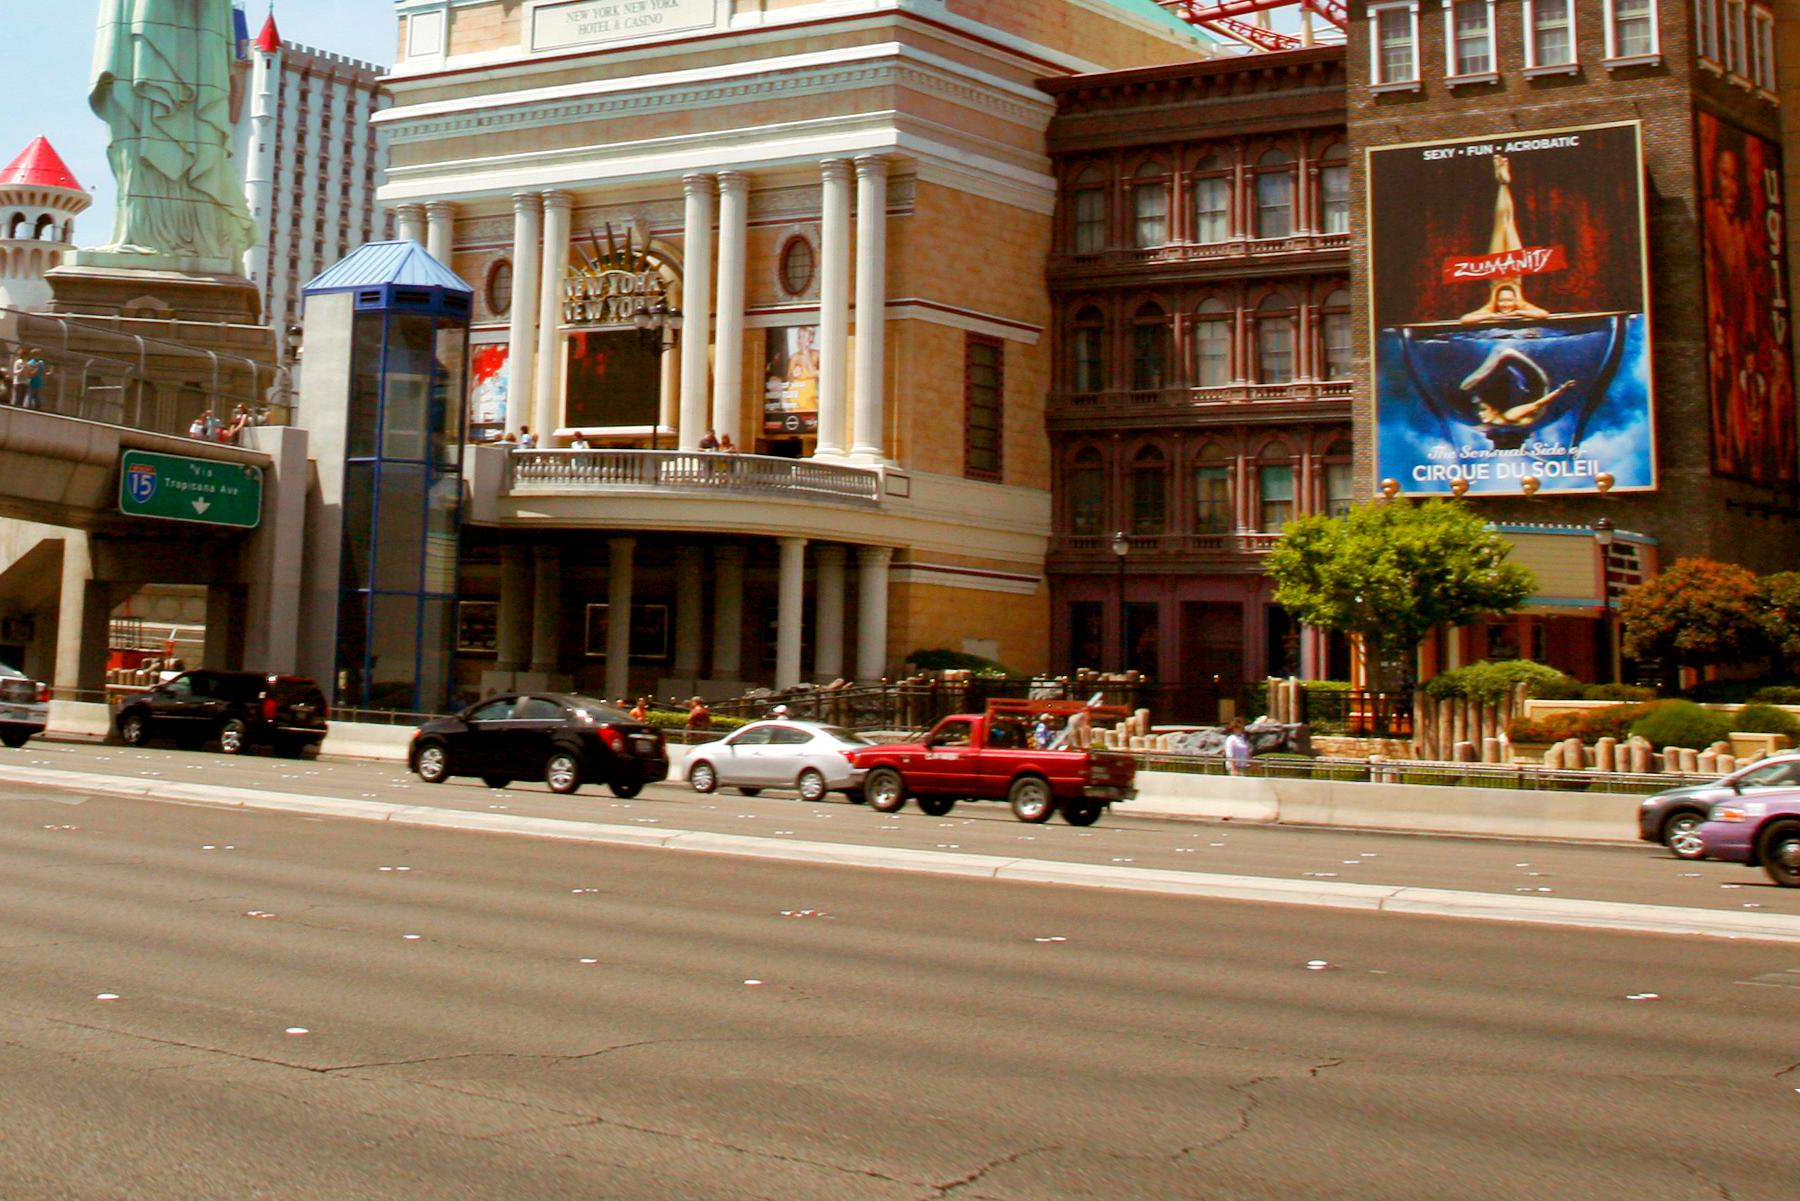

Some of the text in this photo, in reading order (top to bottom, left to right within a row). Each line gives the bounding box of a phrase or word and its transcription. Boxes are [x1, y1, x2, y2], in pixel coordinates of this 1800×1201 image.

[578, 20, 611, 35] HOTEL
[624, 14, 663, 28] CASINO
[1423, 135, 1580, 161] SEXY FUN ACROBATIC
[1460, 443, 1528, 459] Sensual
[1529, 442, 1566, 458] Side
[1412, 459, 1600, 484] CIRQUE DU SOLEIL
[132, 473, 153, 496] 15
[165, 477, 239, 496] Tropicana Ave
